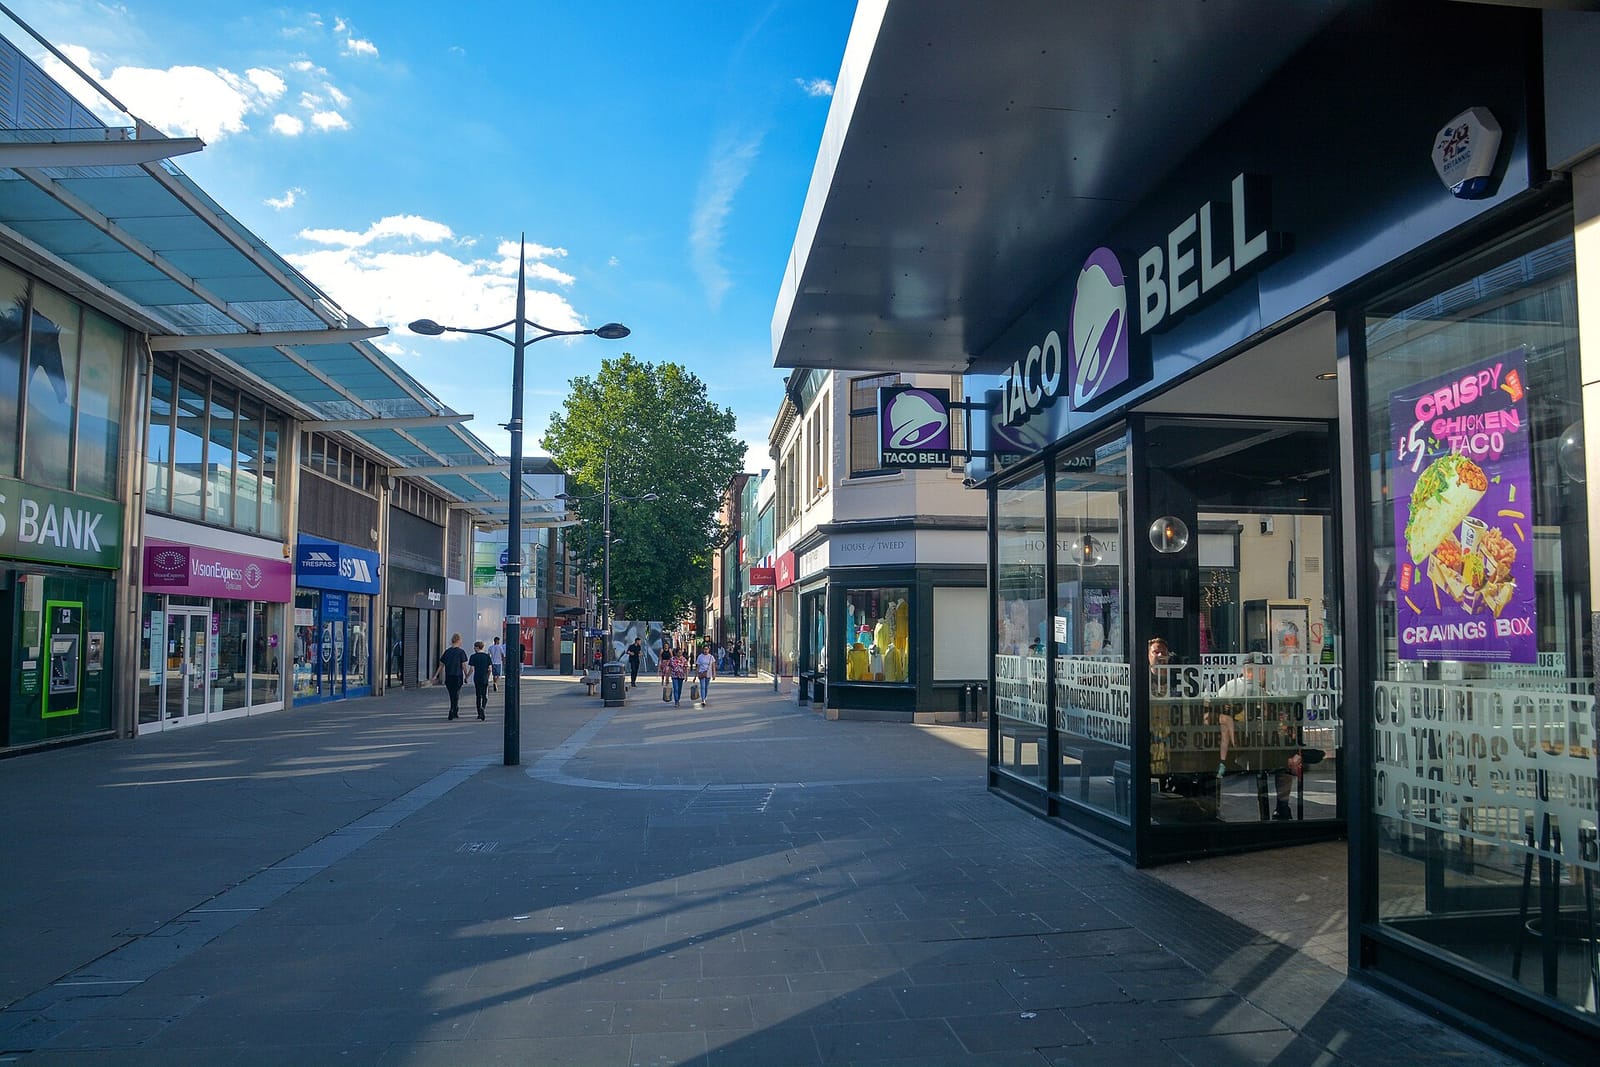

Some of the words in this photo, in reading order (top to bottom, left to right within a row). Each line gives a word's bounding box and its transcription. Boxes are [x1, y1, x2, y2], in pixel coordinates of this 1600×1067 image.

[1000, 331, 1061, 426] TACO
[1138, 172, 1267, 335] BELL
[1415, 363, 1503, 421] CRISPY
[1431, 409, 1520, 438] CHICKEN
[1448, 432, 1504, 455] TACO
[883, 452, 915, 464] TACO
[919, 452, 949, 464] BELL
[18, 499, 103, 553] BANK
[841, 543, 866, 551] HOUSE
[877, 541, 904, 549] TWEED
[302, 560, 337, 568] TRESPASS
[1402, 621, 1487, 645] CRAVINGS
[1495, 616, 1534, 637] BOX
[1070, 686, 1110, 714] QUESADILLA
